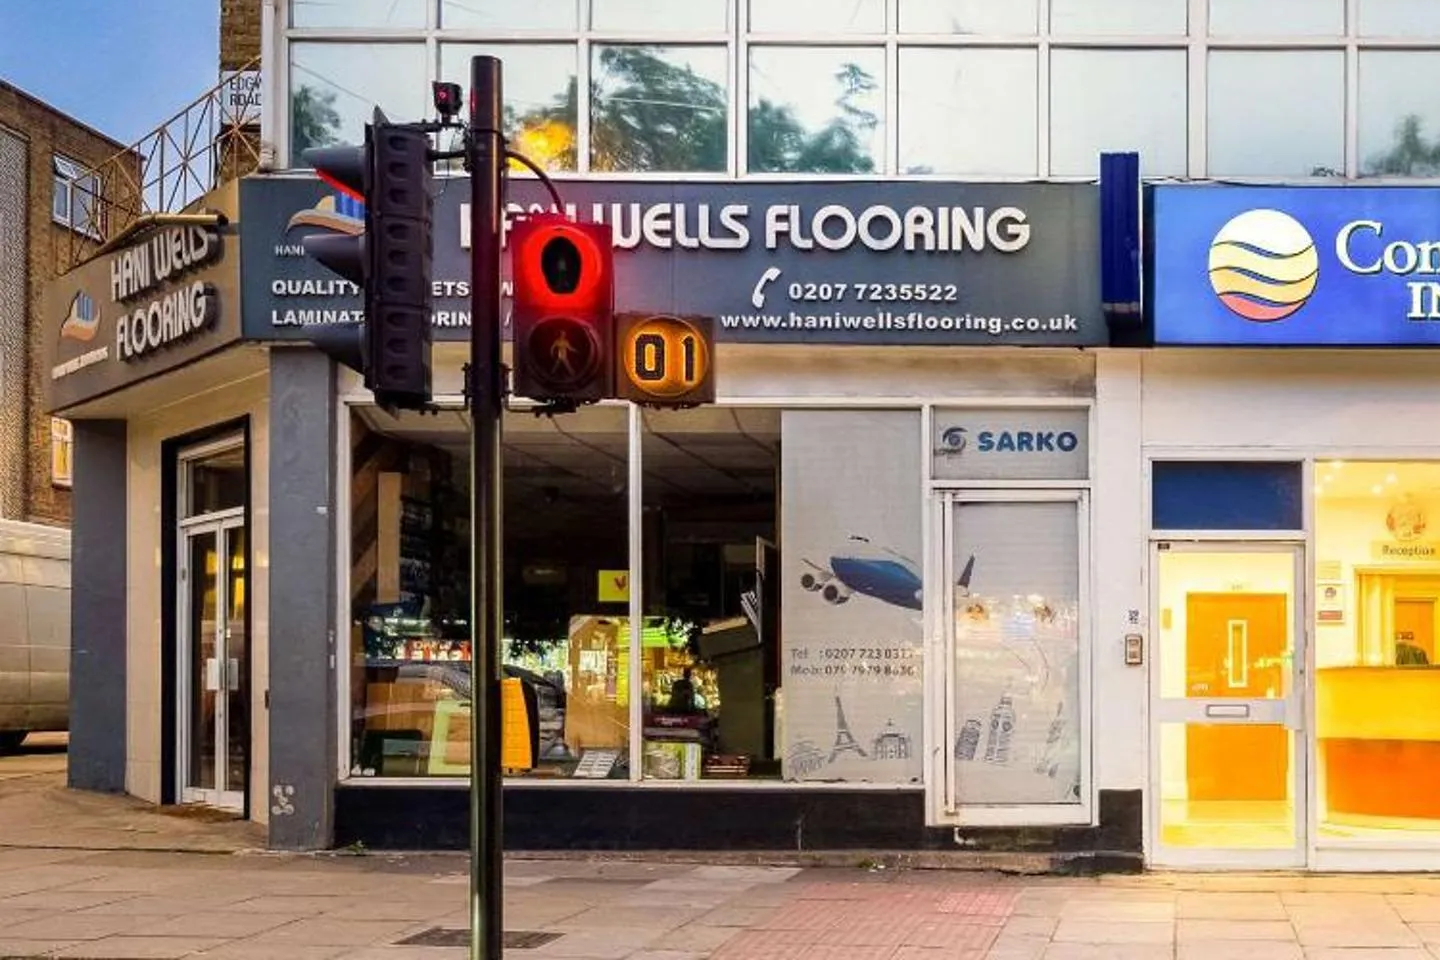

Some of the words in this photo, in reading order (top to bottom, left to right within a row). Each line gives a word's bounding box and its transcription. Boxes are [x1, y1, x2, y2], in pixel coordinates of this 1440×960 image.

[765, 204, 1031, 252] FLOORING
[274, 245, 305, 257] HANI
[111, 242, 151, 302] HANI
[152, 226, 209, 281] WELLS
[271, 279, 361, 296] QUALITY
[788, 283, 847, 300] 0207
[854, 283, 958, 301] 7235522
[116, 280, 207, 361] FLOORING
[271, 309, 366, 326] LAMINAT
[720, 312, 1079, 334] www.haniwellsflooring.co.uk
[634, 333, 696, 382] 01
[977, 431, 1079, 453] SARKO
